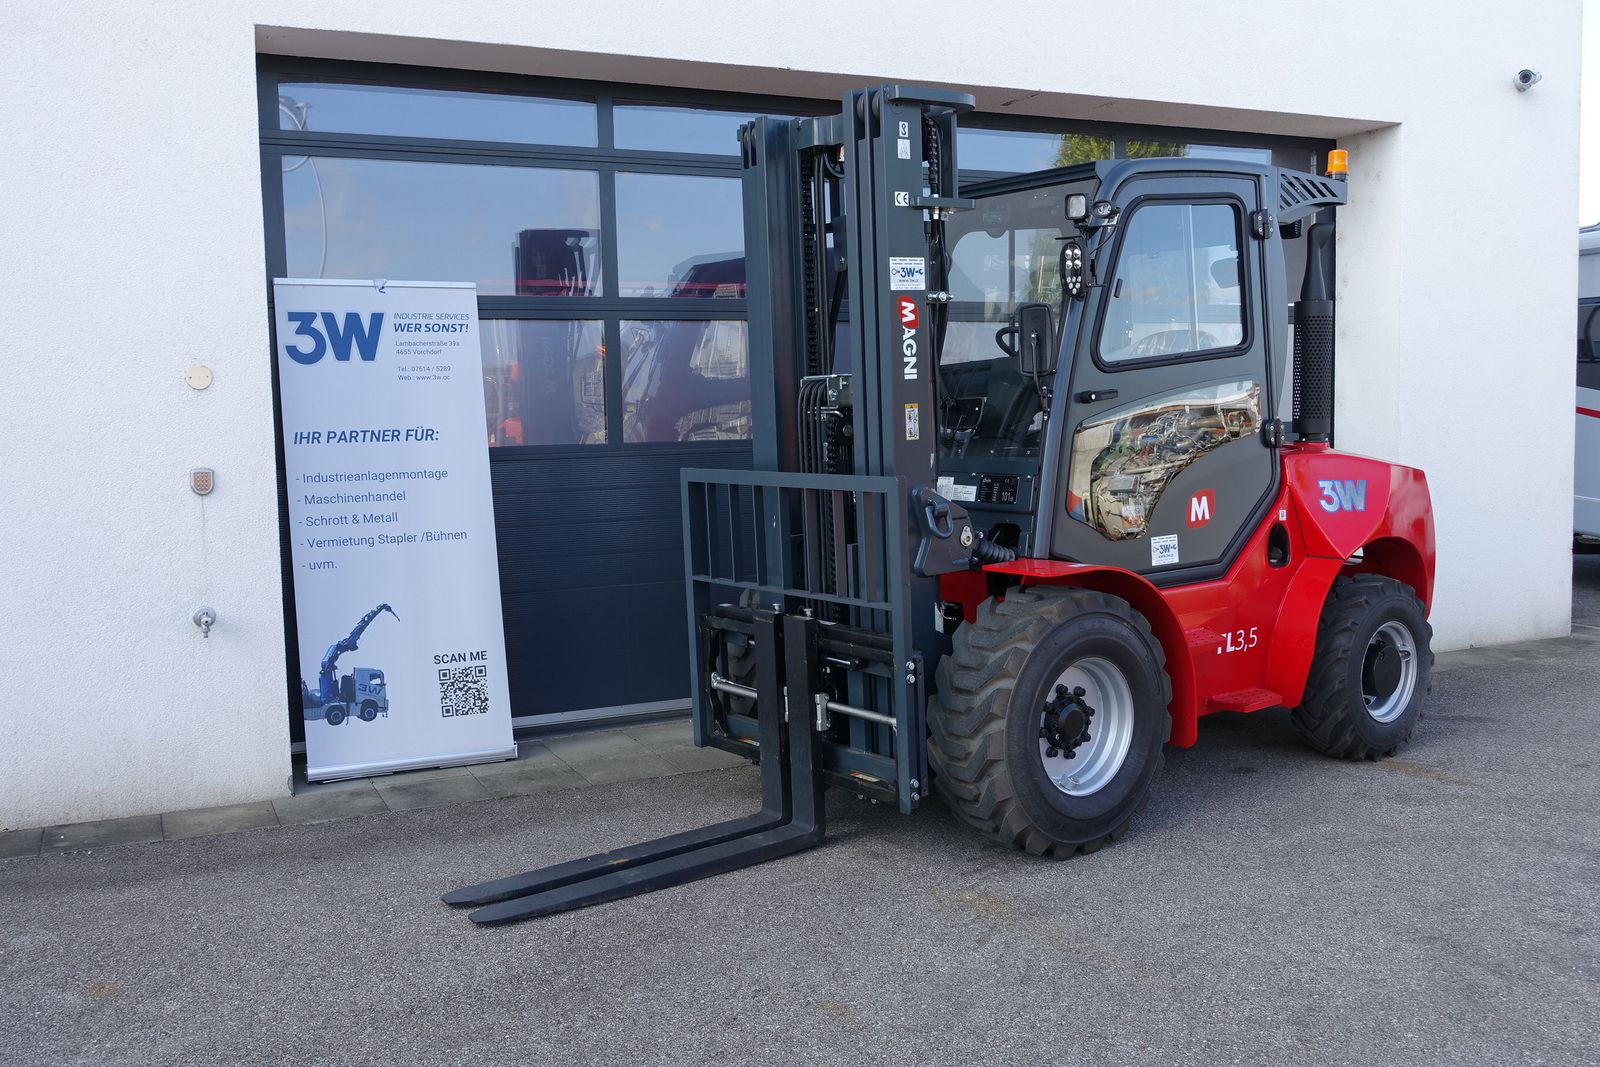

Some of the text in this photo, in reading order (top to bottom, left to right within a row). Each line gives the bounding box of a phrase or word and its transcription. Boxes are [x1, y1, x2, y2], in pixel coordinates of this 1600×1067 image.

[394, 312, 470, 320] INDUSTRIE SERVICES
[394, 322, 468, 332] WER SONST!
[285, 311, 384, 365] 3W
[901, 301, 918, 380] MAGNI
[294, 426, 440, 444] IHR PARTNER FÜR:
[303, 470, 448, 483] Industrieanlagenmontage
[304, 491, 406, 504] Maschinenhandel
[1318, 480, 1366, 512] 3W
[1190, 496, 1210, 522] M
[306, 516, 348, 527] Schrott
[352, 514, 360, 524] &
[363, 512, 398, 524] Metall
[307, 536, 375, 548] Vermietung
[378, 532, 418, 547] Stapler
[309, 560, 338, 570] uvm.
[434, 650, 488, 664] SCAN ME
[358, 684, 384, 695] 3W
